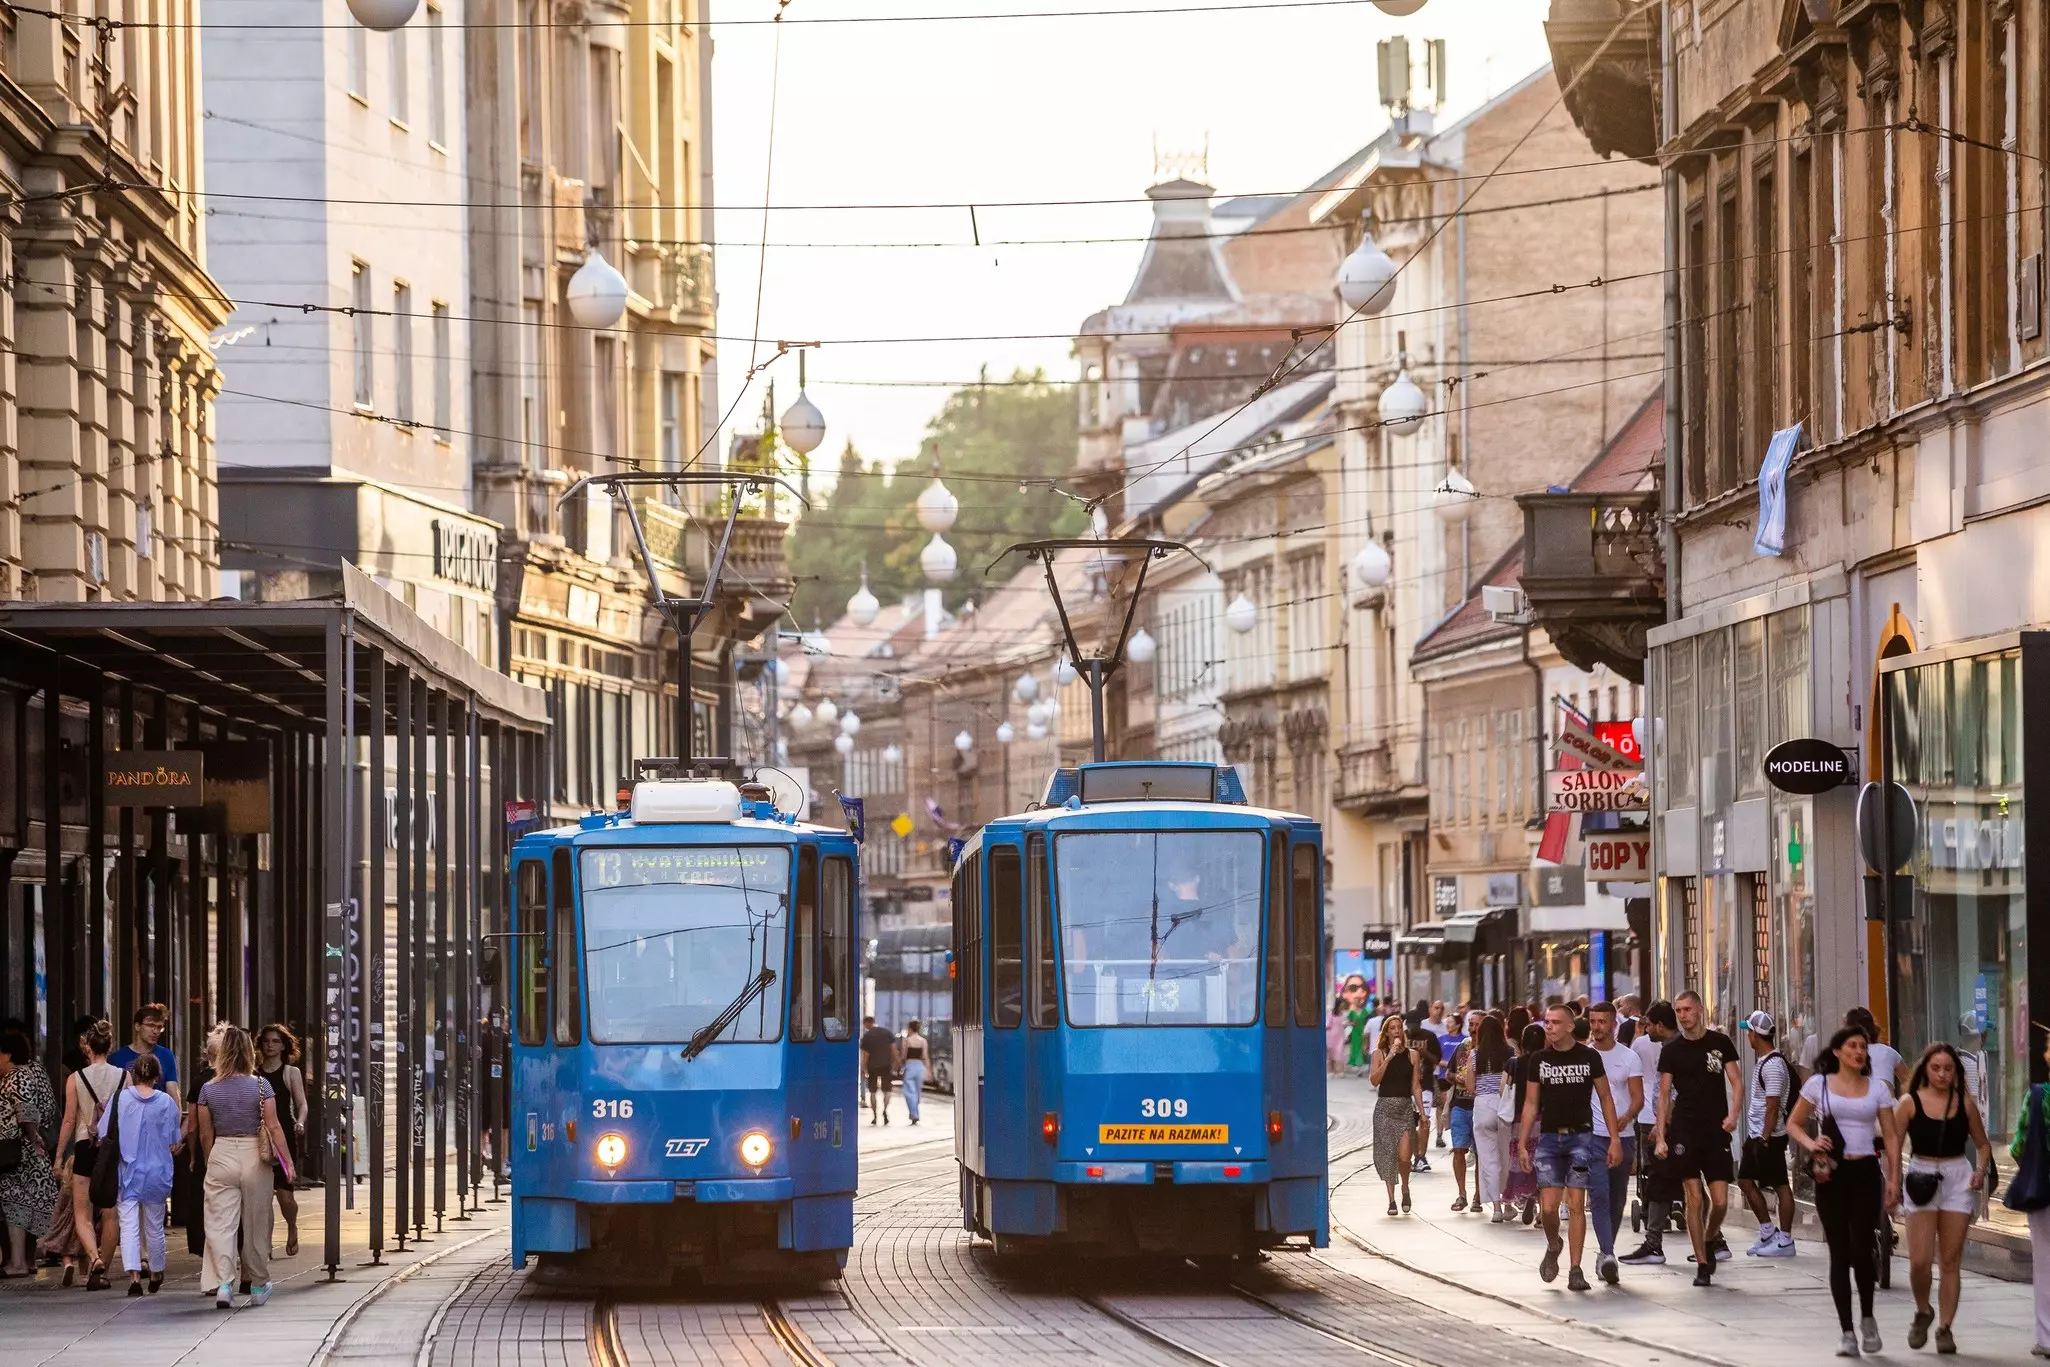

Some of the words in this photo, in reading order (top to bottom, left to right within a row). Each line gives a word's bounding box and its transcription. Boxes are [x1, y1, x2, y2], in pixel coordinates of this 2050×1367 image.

[108, 767, 191, 786] PANDORA
[1769, 761, 1843, 773] MODELINE
[1562, 770, 1626, 791] SALON
[1589, 841, 1650, 871] COPY
[589, 852, 622, 886] 13
[1543, 1064, 1591, 1078] BOXEUR
[1550, 1077, 1564, 1085] DES
[1566, 1076, 1585, 1084] RUES
[592, 1099, 634, 1119] 316
[1141, 1098, 1188, 1118] 309
[541, 1122, 555, 1141] 316
[813, 1121, 828, 1140] 316
[1106, 1129, 1146, 1140] PAZITE
[1149, 1129, 1165, 1140] NA
[1168, 1128, 1222, 1140] RAZMAK!
[665, 1138, 710, 1157] ZET
